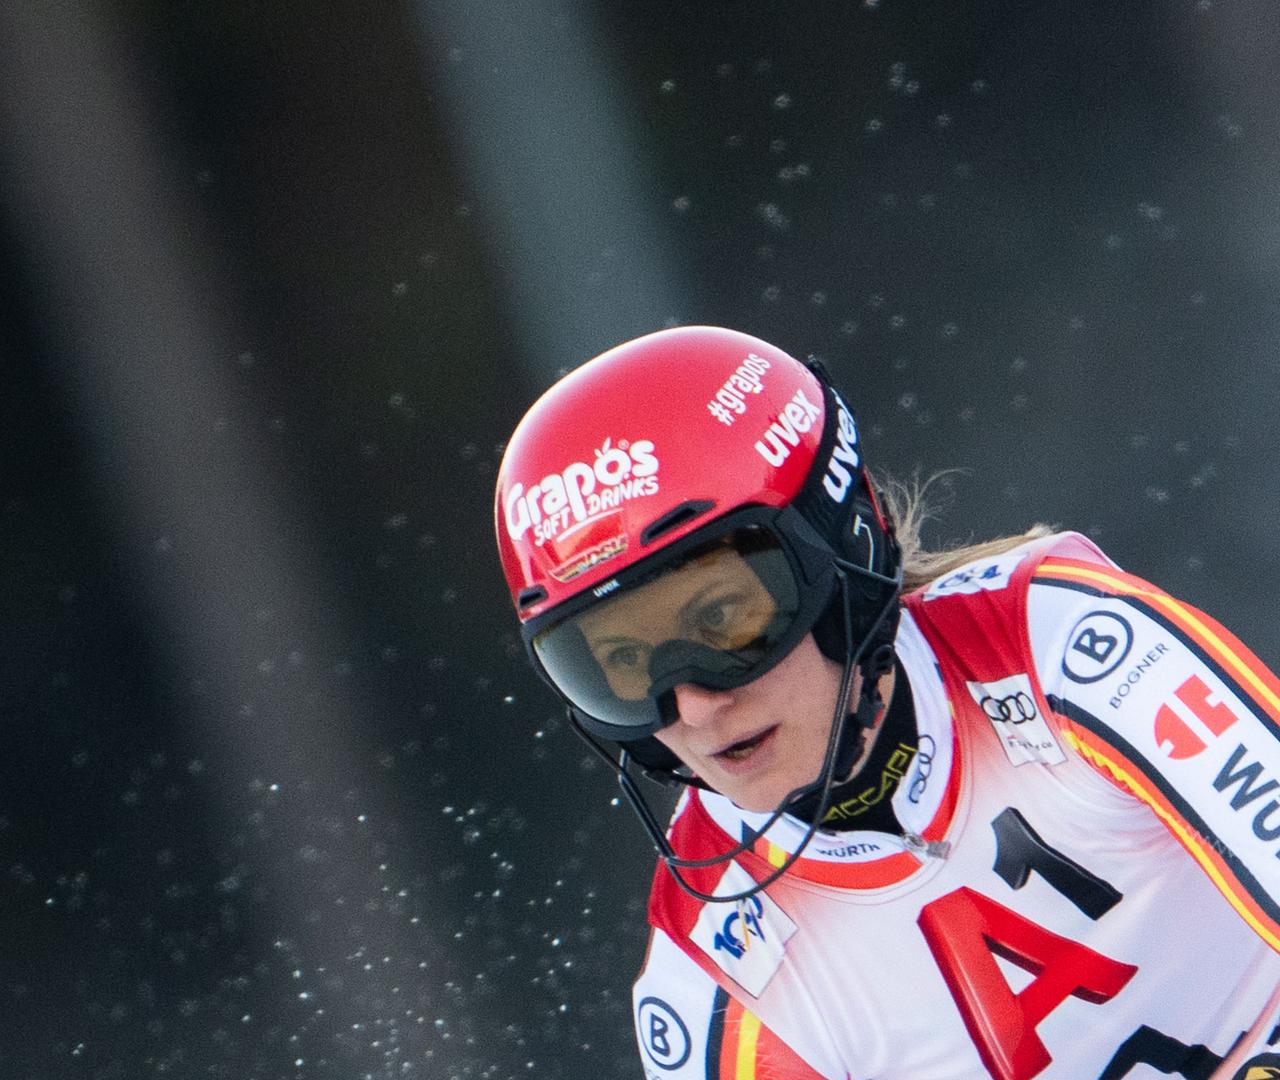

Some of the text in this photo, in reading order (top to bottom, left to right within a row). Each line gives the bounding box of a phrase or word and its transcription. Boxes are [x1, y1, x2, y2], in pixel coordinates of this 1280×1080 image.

[754, 390, 821, 467] uvex
[534, 476, 659, 547] SOFT DRINKS
[1110, 642, 1170, 709] BOGNER
